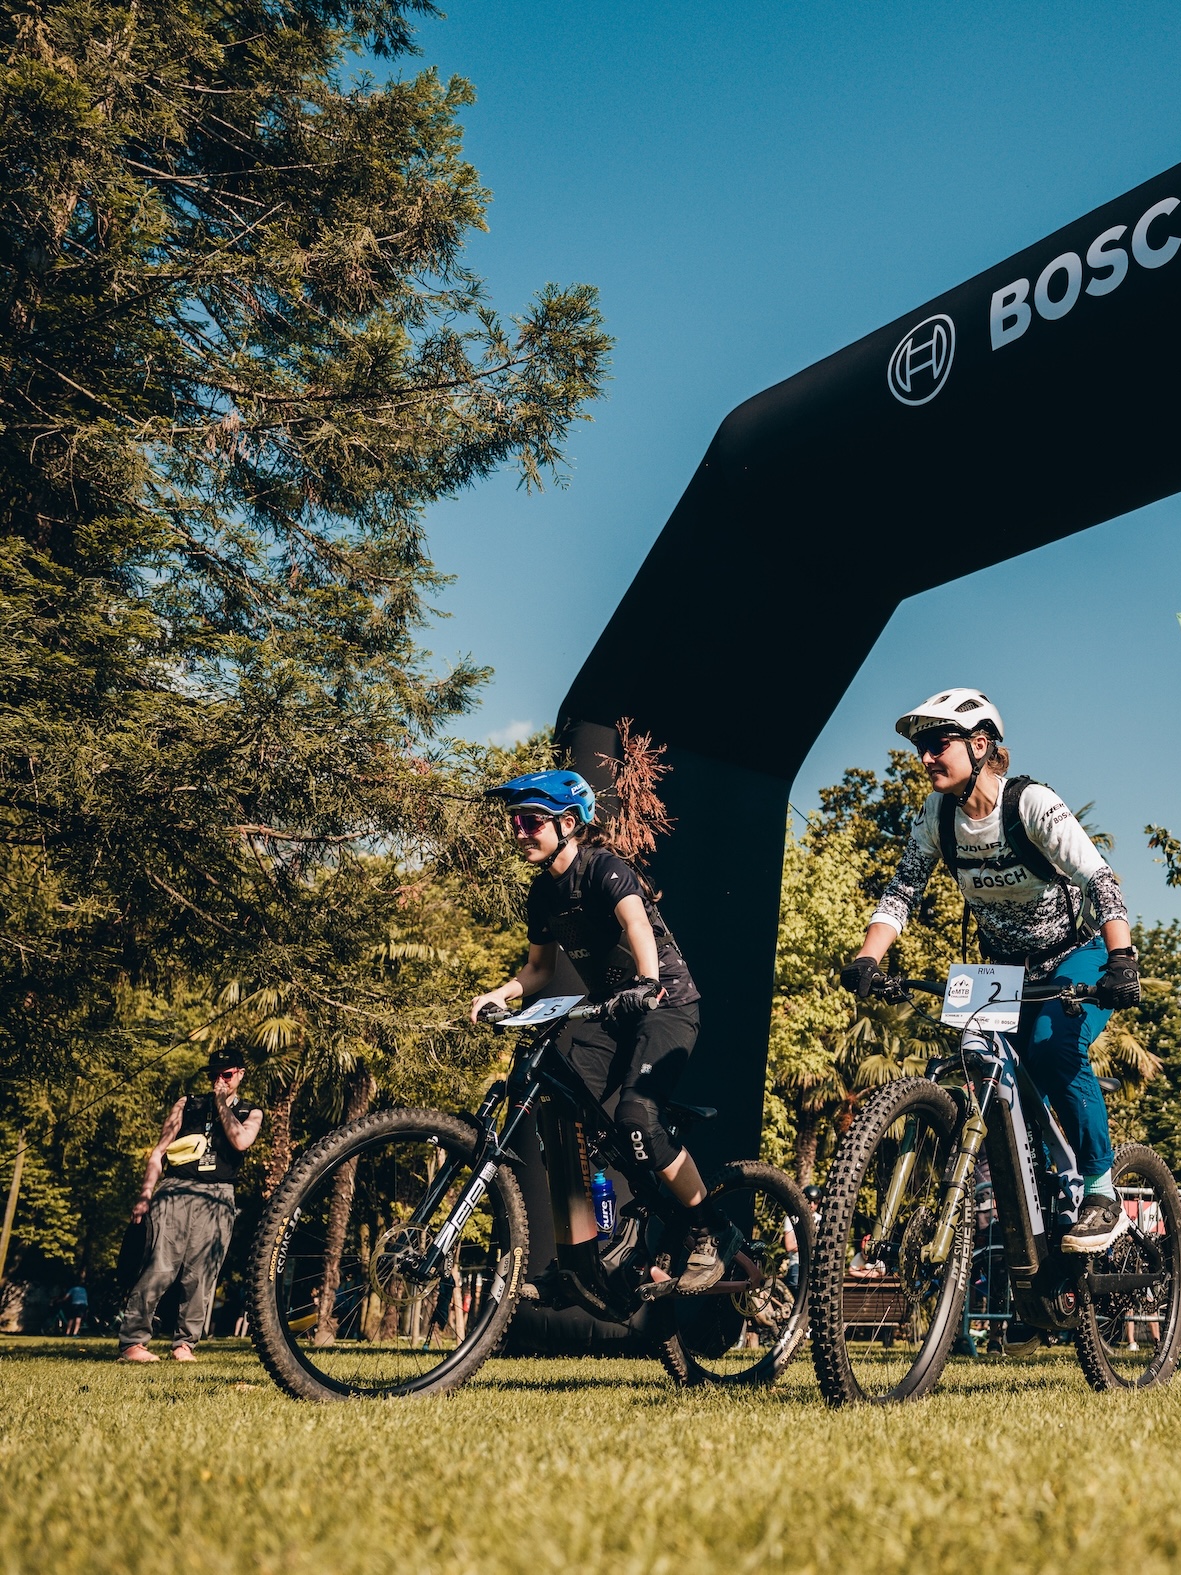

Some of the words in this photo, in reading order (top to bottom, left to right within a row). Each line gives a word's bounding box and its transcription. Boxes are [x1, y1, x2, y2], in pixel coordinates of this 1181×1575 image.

[1053, 811, 1072, 824] BOS
[973, 867, 1027, 888] BOSCH
[988, 982, 1002, 1002] 2
[544, 1004, 562, 1016] 5
[954, 1219, 964, 1255] SWISS
[268, 1246, 279, 1281] ARGOTAL
[951, 1257, 960, 1280] DT
[958, 1227, 971, 1291] MAGIC
